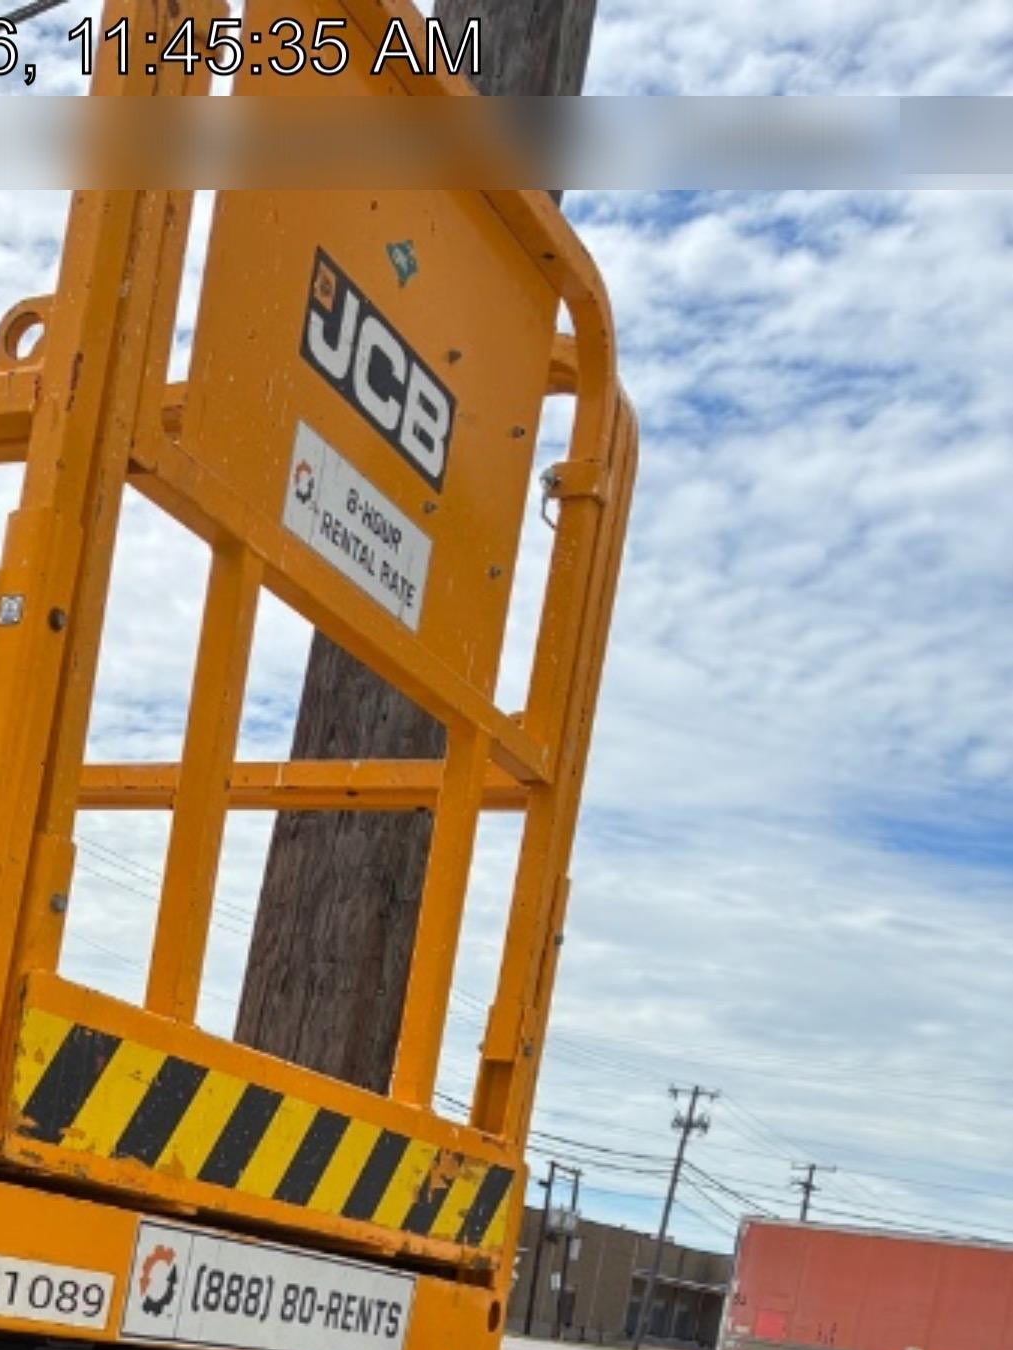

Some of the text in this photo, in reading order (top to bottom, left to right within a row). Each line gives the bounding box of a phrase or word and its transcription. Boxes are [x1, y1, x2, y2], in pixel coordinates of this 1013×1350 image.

[307, 288, 451, 479] JCB
[320, 509, 417, 609] RENTAL RATE
[346, 487, 403, 555] 8-HOUR
[190, 1263, 403, 1340] (888) 80-RENTS
